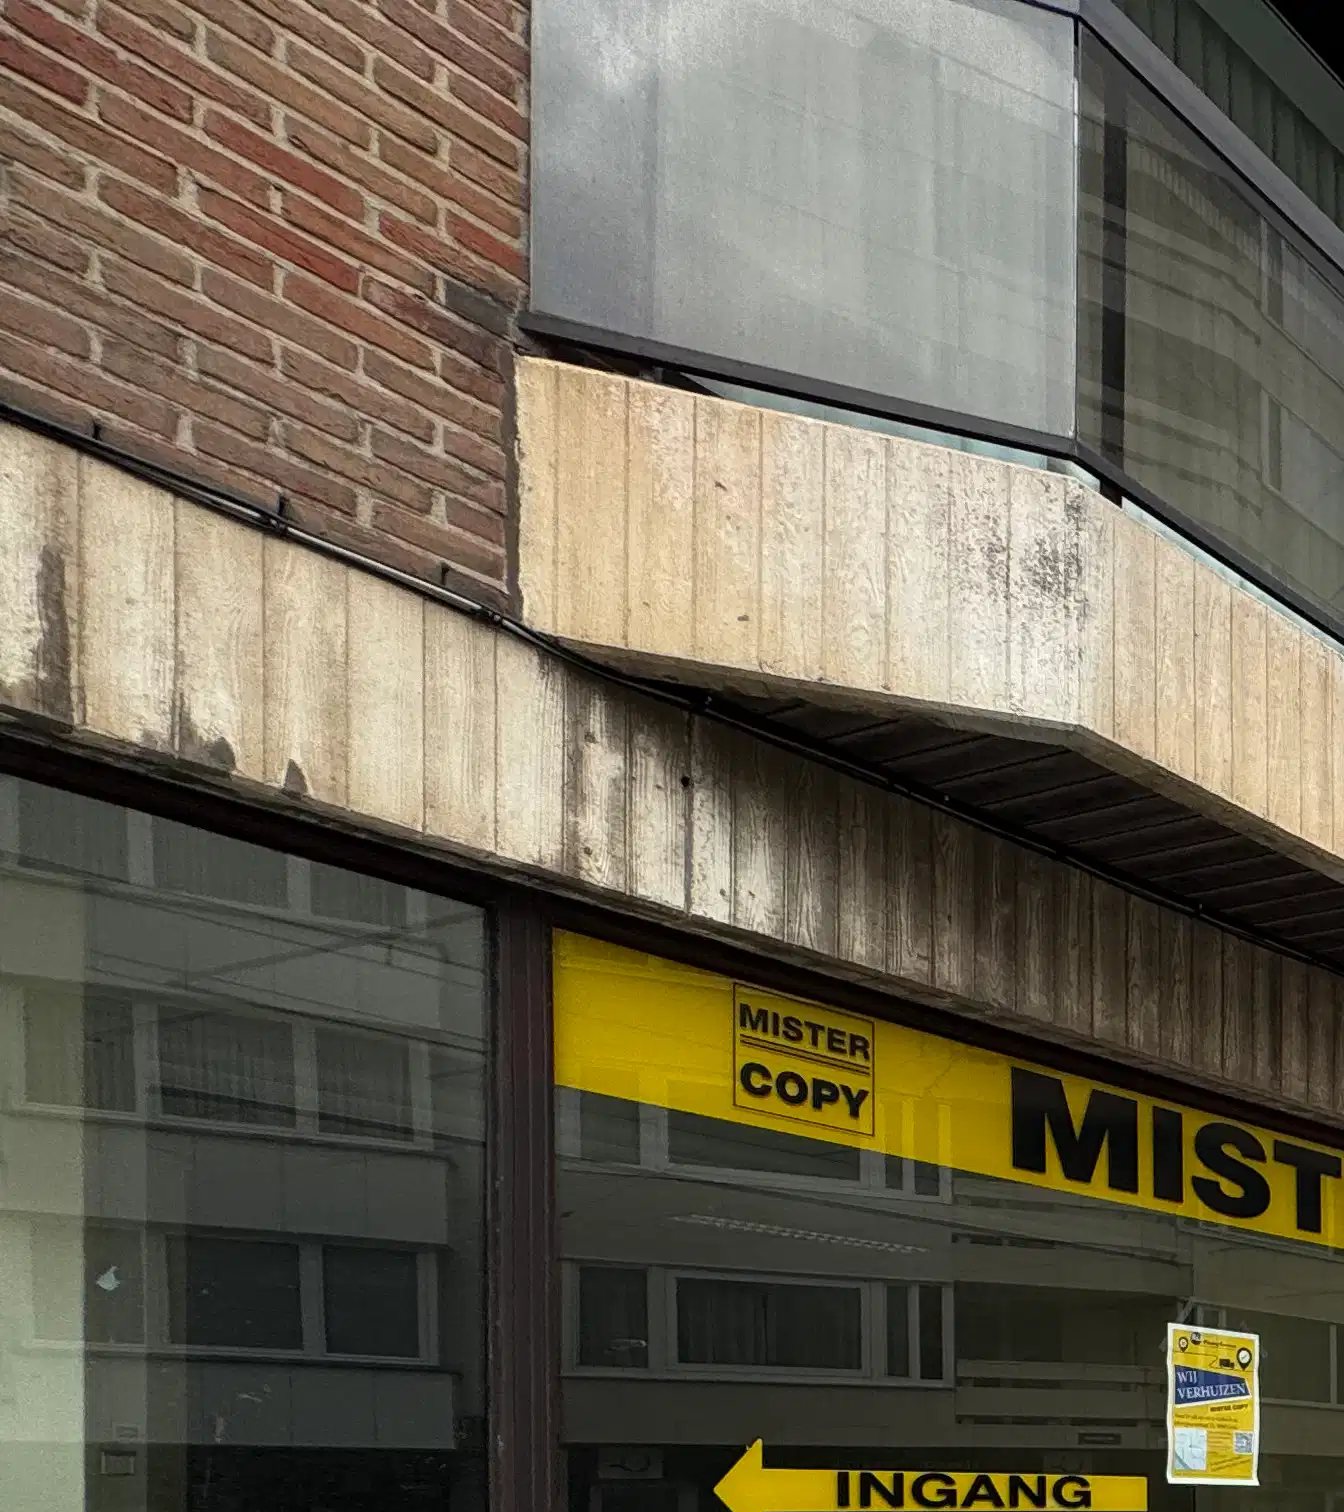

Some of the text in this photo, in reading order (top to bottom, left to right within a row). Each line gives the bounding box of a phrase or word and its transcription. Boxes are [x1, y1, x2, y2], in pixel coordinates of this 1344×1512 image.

[739, 1003, 870, 1061] MISTER
[740, 1062, 869, 1118] COPY
[1177, 1371, 1197, 1383] WIJ
[1177, 1383, 1246, 1399] VERHUIZEN
[837, 1471, 1091, 1508] INGANG
